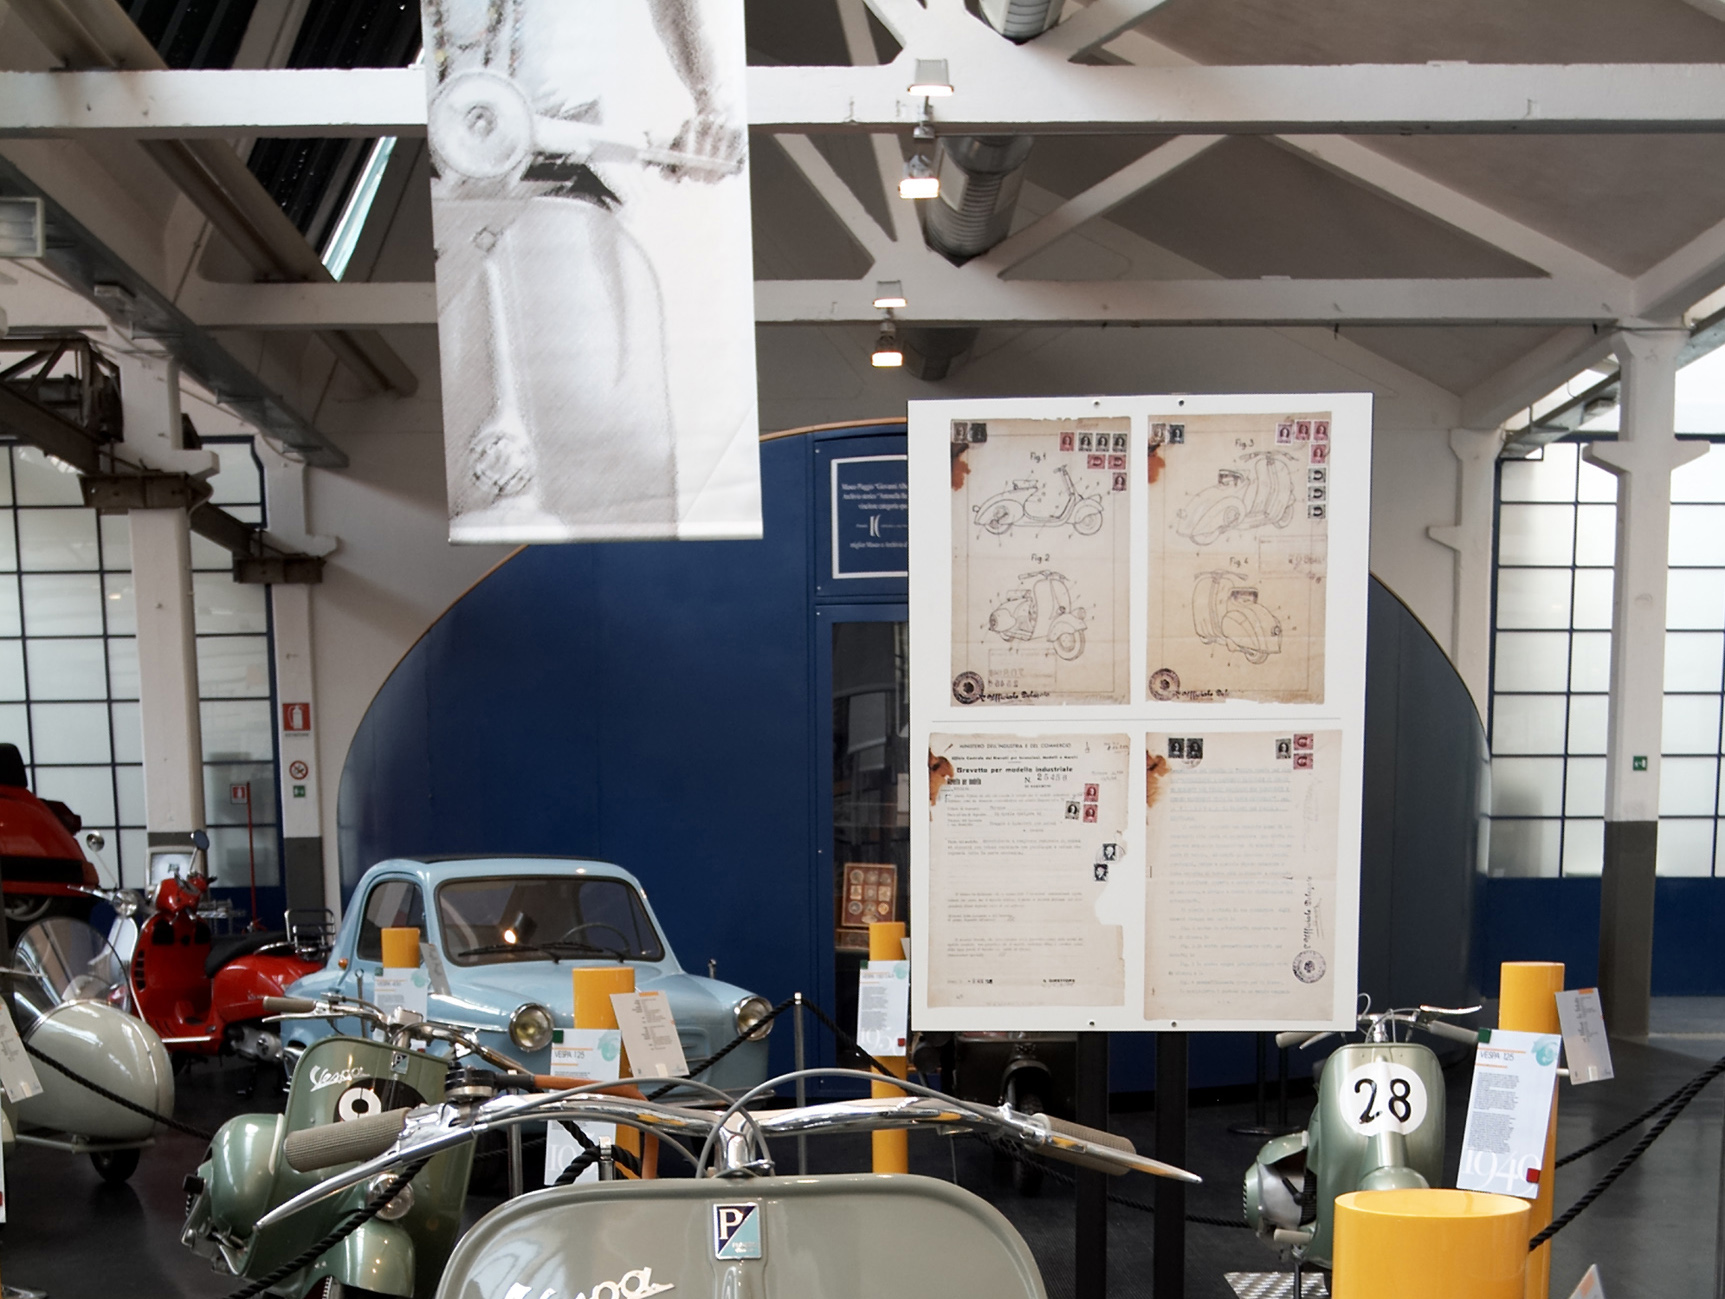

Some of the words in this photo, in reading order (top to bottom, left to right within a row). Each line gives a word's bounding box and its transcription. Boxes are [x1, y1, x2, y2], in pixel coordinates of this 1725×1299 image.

[310, 1065, 370, 1092] Vespa
[1354, 1078, 1412, 1124] 28
[719, 1208, 744, 1240] P
